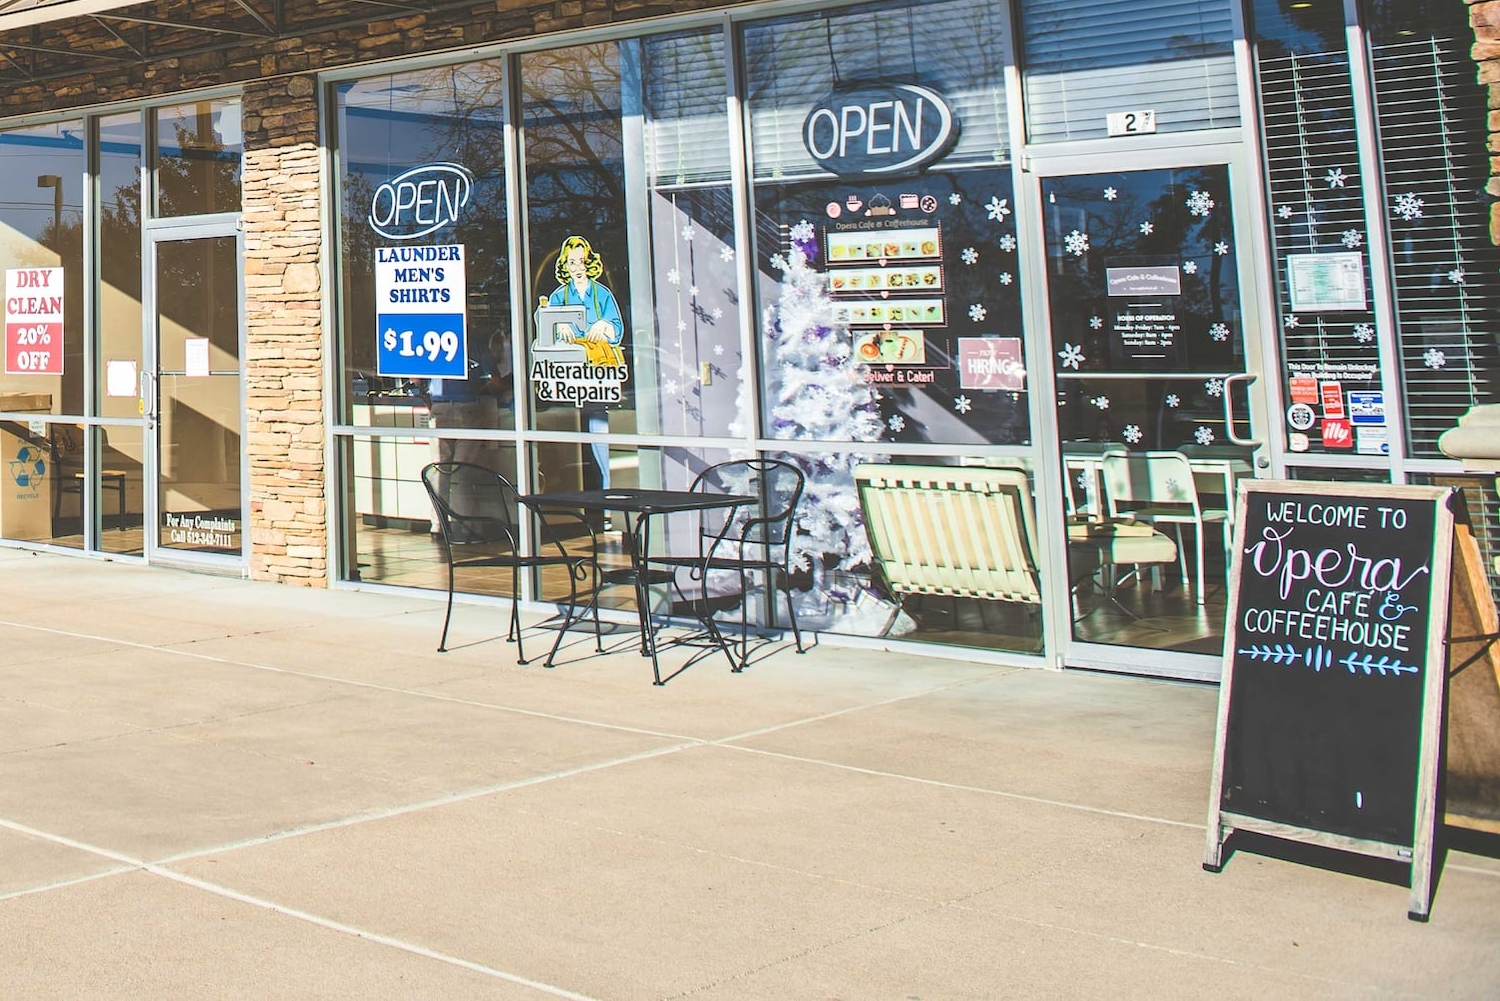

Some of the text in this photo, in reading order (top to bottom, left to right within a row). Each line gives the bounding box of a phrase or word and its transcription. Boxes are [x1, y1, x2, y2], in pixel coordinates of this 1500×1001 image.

[807, 97, 924, 160] OPEN
[371, 178, 461, 227] OPEN
[835, 222, 857, 230] Opera
[378, 245, 461, 264] LAUNDER
[16, 269, 53, 288] DRY
[394, 267, 445, 283] MEN'S
[7, 296, 63, 315] CLEAN
[389, 288, 451, 304] SHIRTS
[17, 324, 51, 345] 20%
[383, 327, 459, 362] $1.99
[17, 350, 51, 370] OFF
[968, 358, 1010, 375] HIRING
[532, 360, 627, 381] Alterations
[897, 370, 905, 383] &
[907, 370, 935, 383] Cater!
[539, 381, 621, 406] & Repairs
[1323, 422, 1349, 443] illy
[165, 513, 236, 532] For Any Complaints
[1267, 501, 1407, 529] WELCOME TO
[170, 529, 186, 543] Call
[1244, 526, 1429, 600] Opera
[1378, 591, 1418, 620] &
[1244, 608, 1411, 651] COFFEEHOUSE
